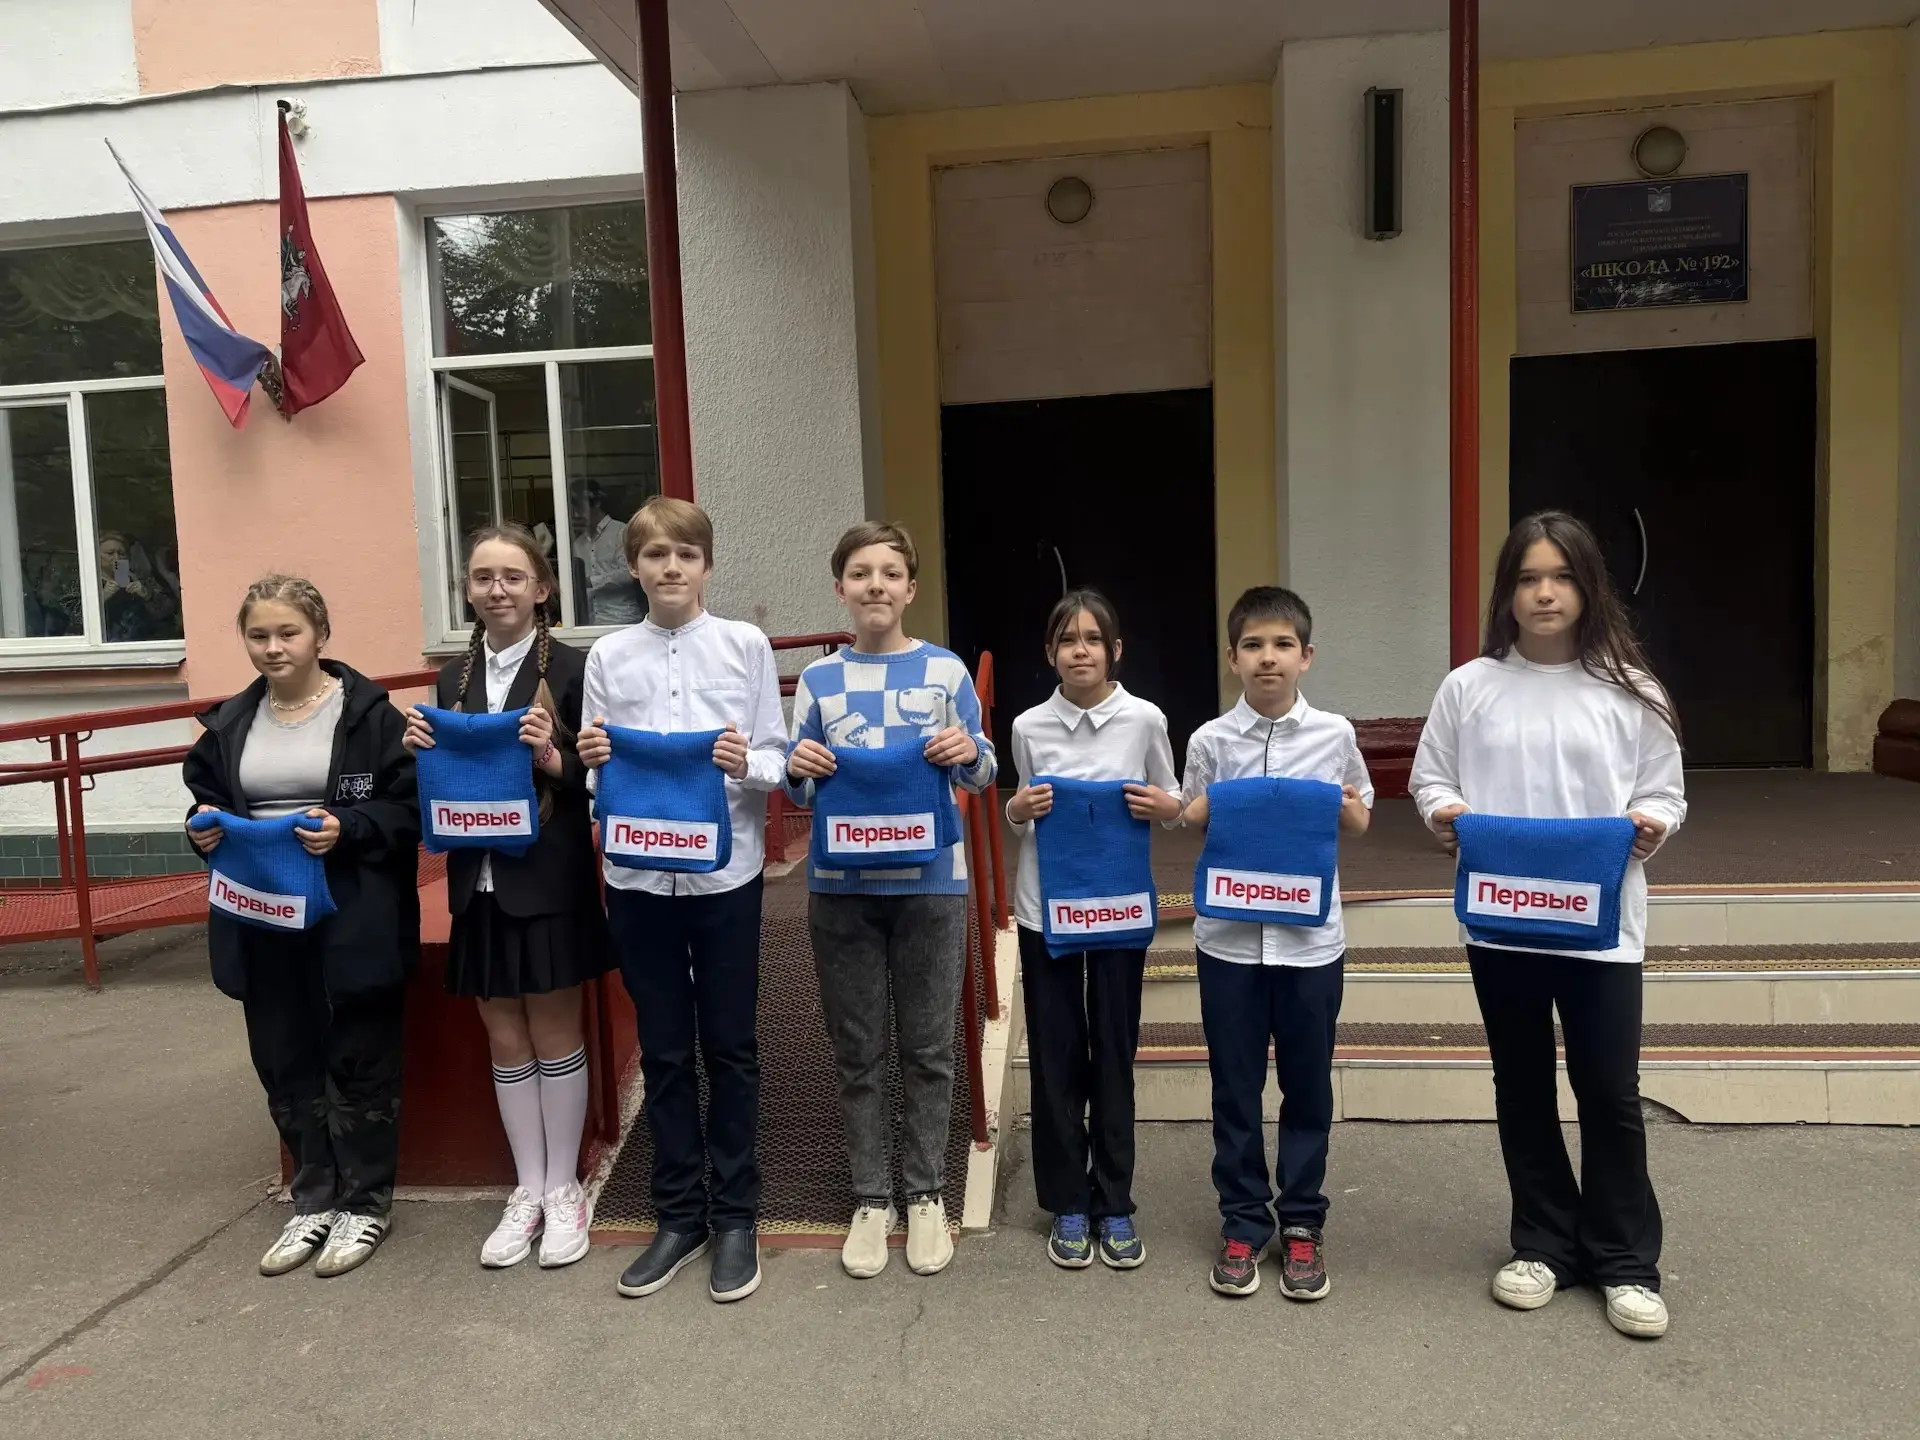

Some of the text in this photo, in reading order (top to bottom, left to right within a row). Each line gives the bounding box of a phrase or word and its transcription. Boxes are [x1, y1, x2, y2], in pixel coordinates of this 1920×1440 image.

[1580, 254, 1740, 279] «ШКОЛА № 192»
[438, 807, 521, 832] Первые
[614, 823, 708, 851] Первые
[835, 823, 926, 848] Первые
[215, 880, 296, 919] Первые
[1214, 875, 1311, 904] Первые
[1477, 880, 1589, 913] Первые
[1055, 903, 1143, 928] Первые
